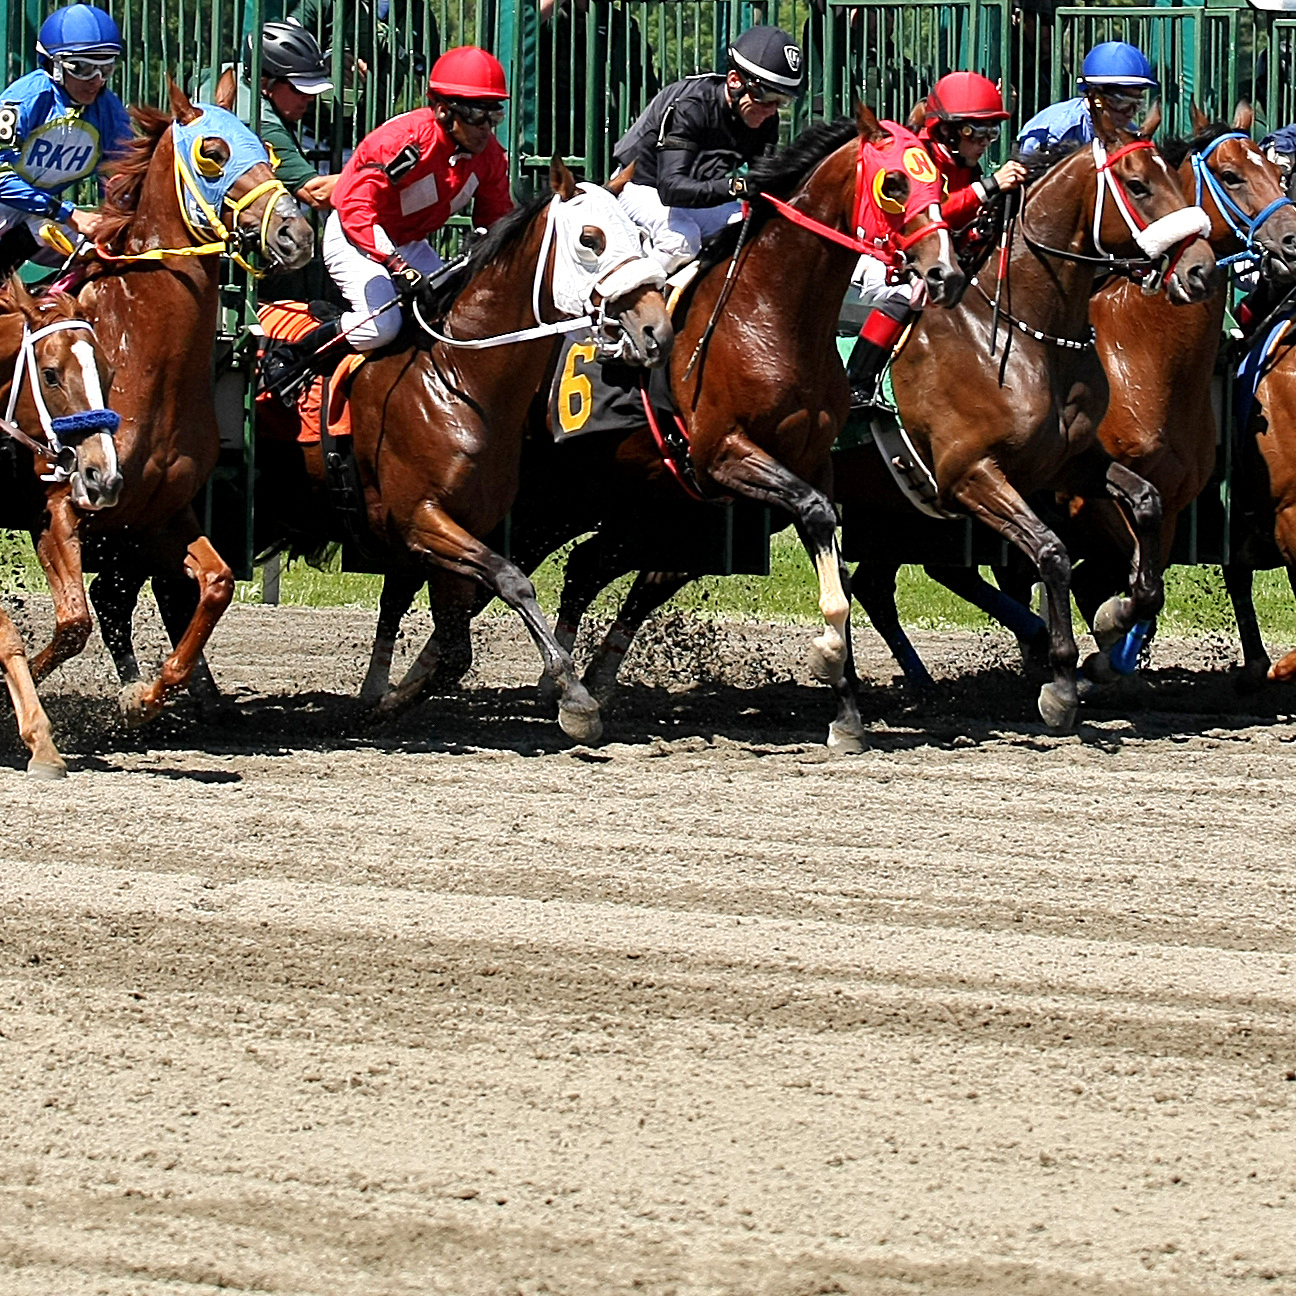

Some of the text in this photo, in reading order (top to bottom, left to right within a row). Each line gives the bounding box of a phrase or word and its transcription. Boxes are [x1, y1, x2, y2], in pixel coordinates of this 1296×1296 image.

[25, 138, 93, 172] RKH
[389, 149, 417, 176] 7
[558, 342, 597, 433] 6
